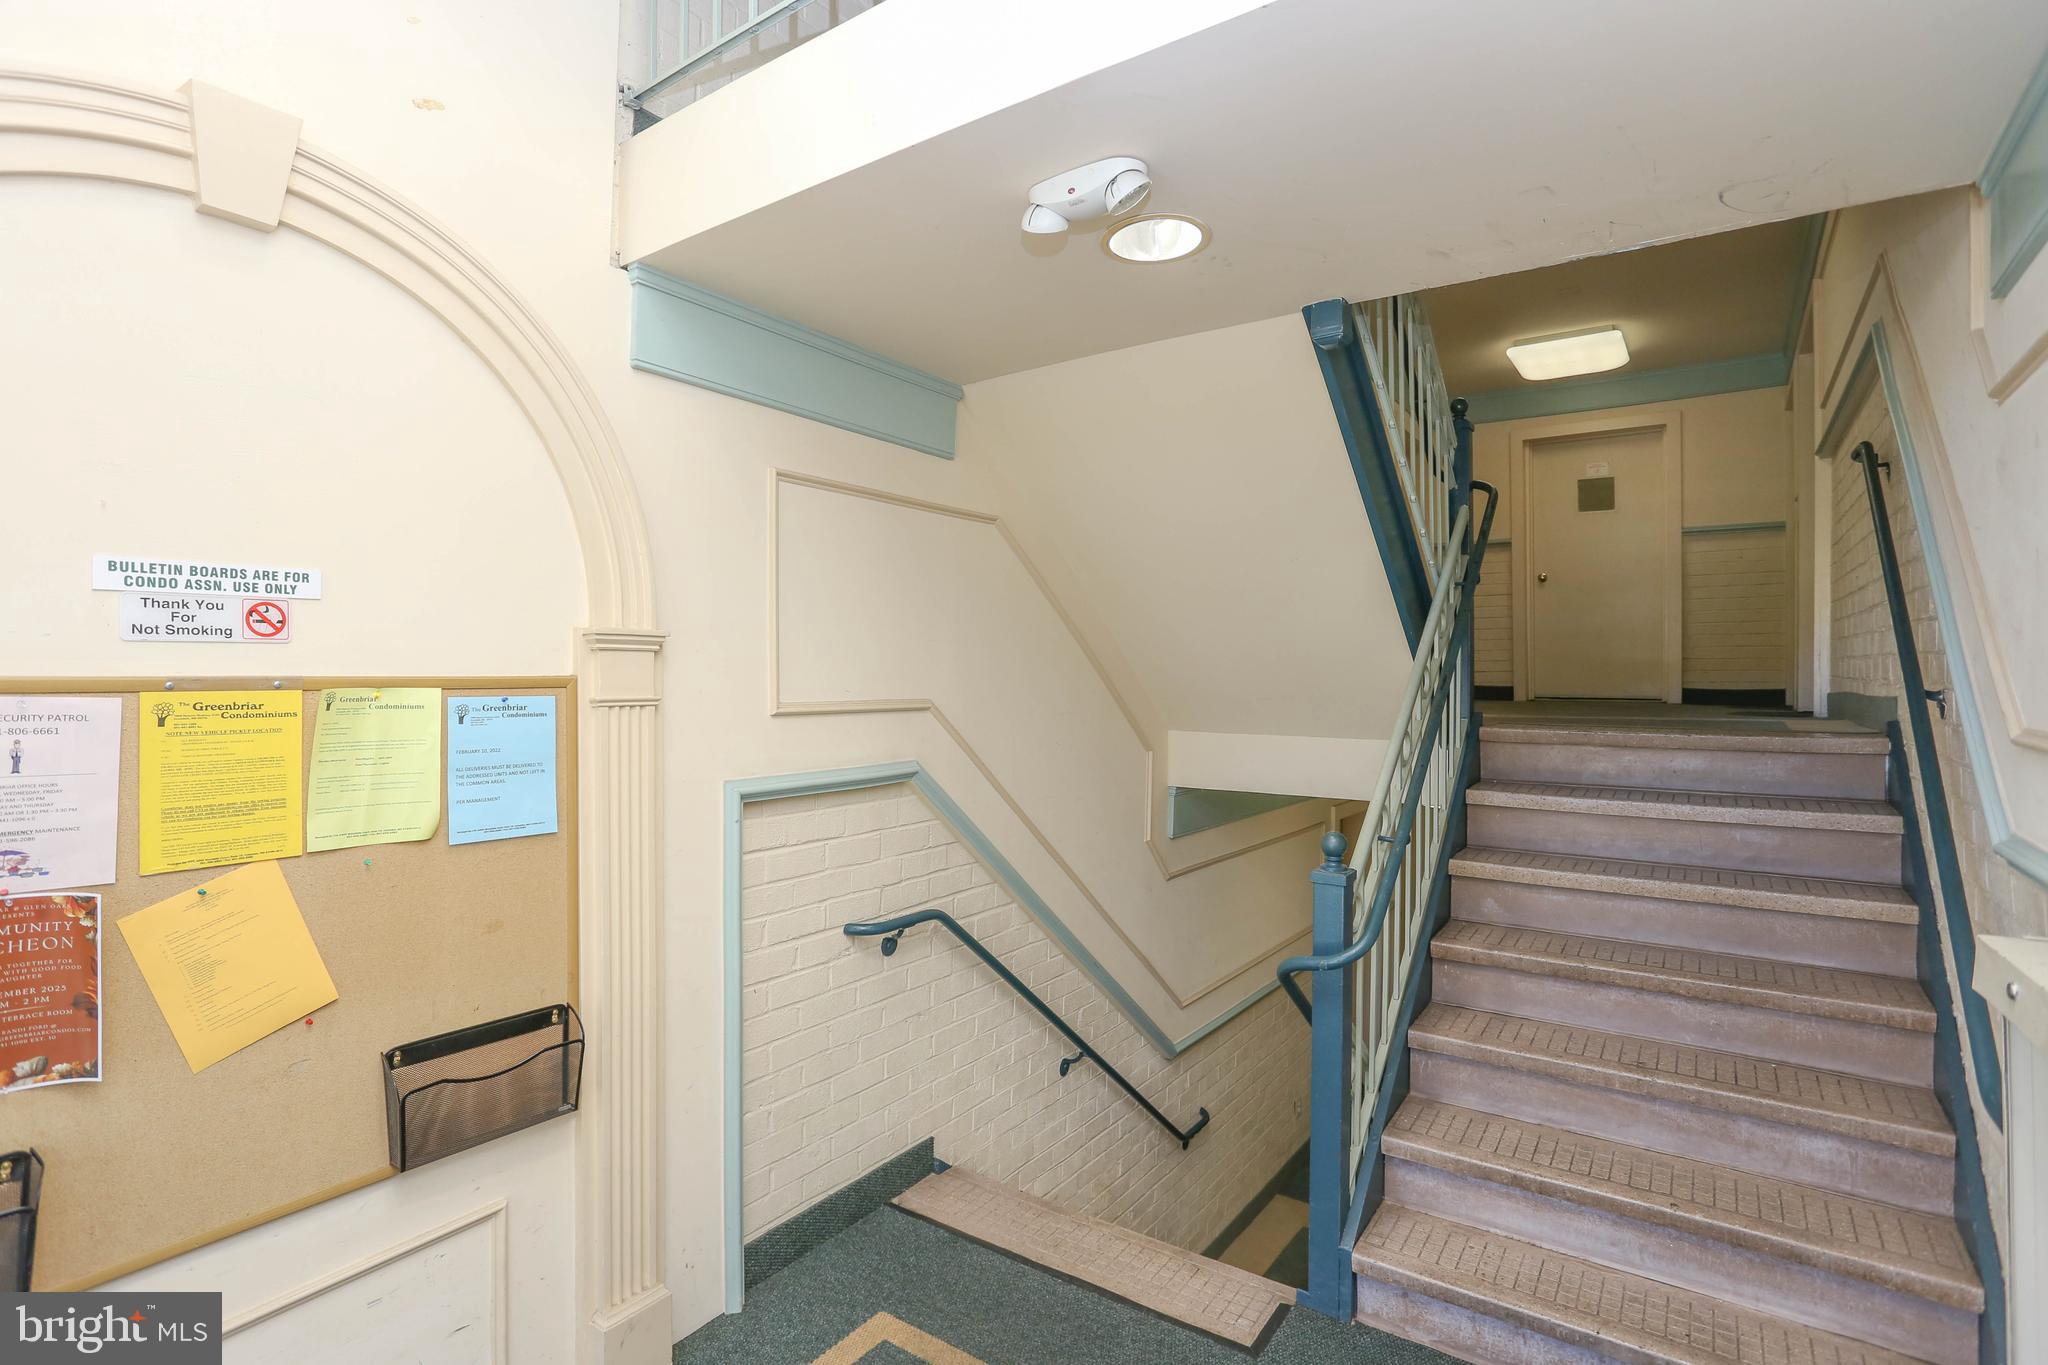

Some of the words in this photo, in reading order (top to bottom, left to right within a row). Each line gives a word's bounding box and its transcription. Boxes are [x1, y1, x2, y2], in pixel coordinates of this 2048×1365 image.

[107, 560, 183, 576] BULLETIN
[189, 565, 248, 580] BOARDS
[252, 569, 279, 582] ARE
[284, 571, 311, 584] FOR
[123, 575, 178, 589] CONDO
[184, 578, 227, 592] ASSN.
[233, 580, 259, 593] USE
[265, 582, 298, 595] ONLY
[140, 597, 190, 610] Thank
[198, 599, 225, 611] You
[170, 611, 197, 623] For
[131, 623, 160, 635] Not
[165, 624, 233, 639] Smoking
[339, 695, 377, 703] Greenbriar
[192, 701, 264, 711] Greenbriar
[482, 704, 528, 712] Greenbriar
[47, 714, 90, 722] PATROL
[221, 711, 298, 719] Condominiums
[466, 795, 501, 804] MANAGEMENT
[34, 826, 80, 834] MAINTENANCE
[8, 960, 54, 969] TOGETHER
[3, 968, 28, 976] WITH
[31, 965, 57, 973] GOOD
[34, 995, 50, 1004] PM
[2, 1011, 44, 1023] TERRACE
[47, 1009, 73, 1017] ROOM
